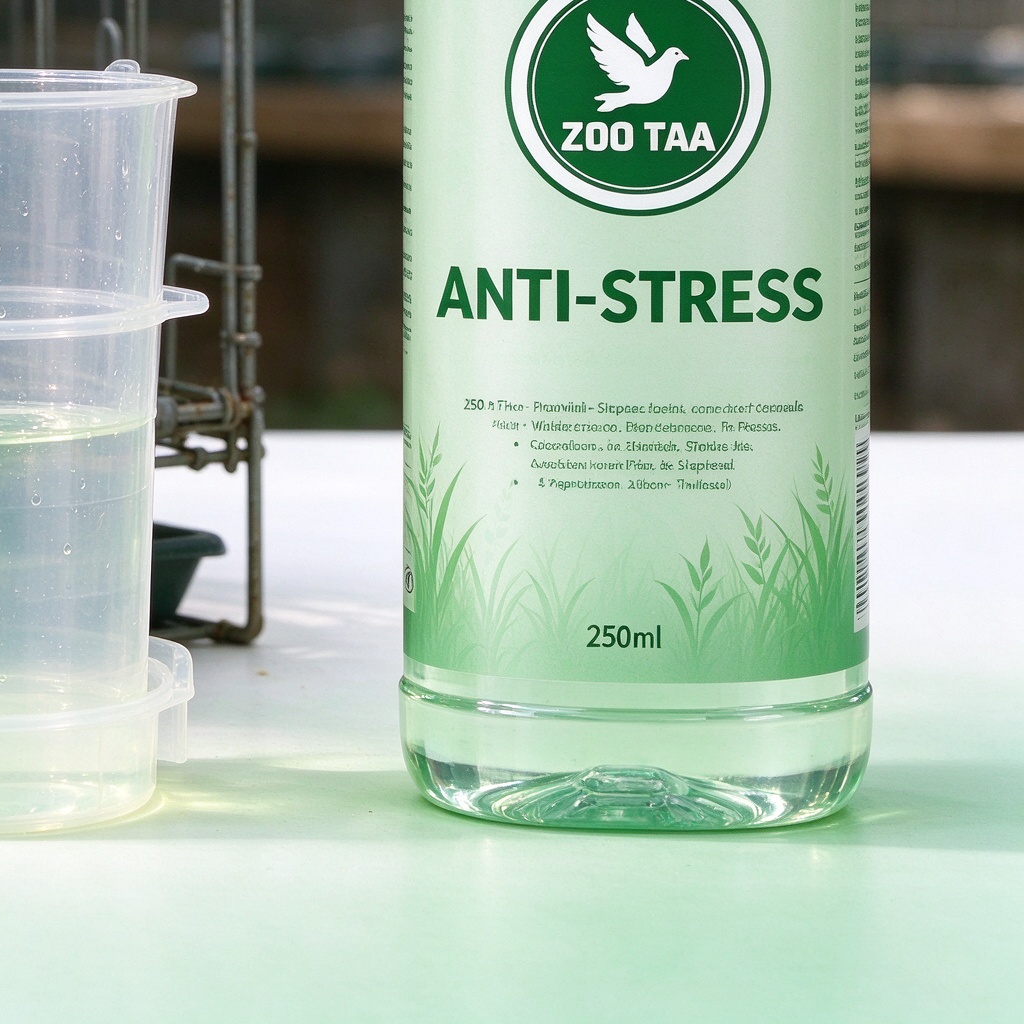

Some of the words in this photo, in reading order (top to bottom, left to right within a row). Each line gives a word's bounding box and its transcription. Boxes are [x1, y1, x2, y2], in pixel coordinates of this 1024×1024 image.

[561, 121, 634, 152] ZOO
[644, 121, 716, 152] TAA
[436, 265, 824, 324] ANTI-STRESS
[586, 624, 661, 649] 250ml
